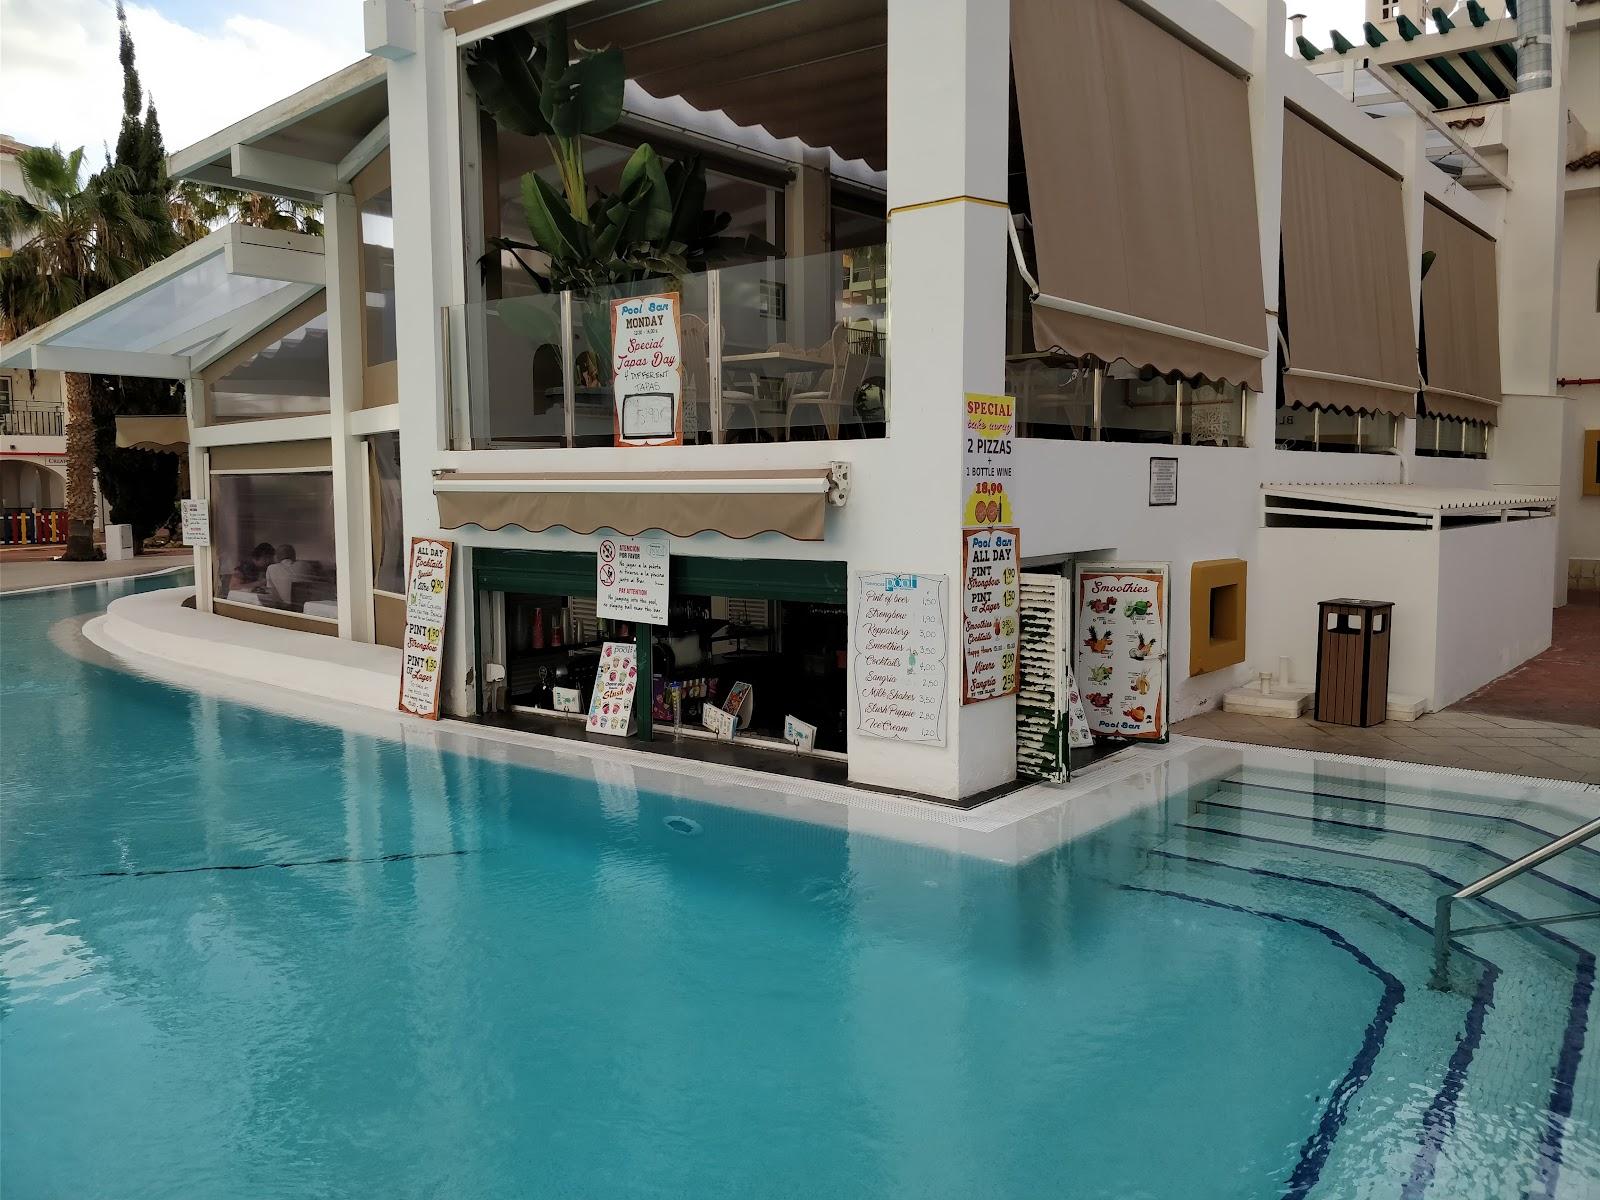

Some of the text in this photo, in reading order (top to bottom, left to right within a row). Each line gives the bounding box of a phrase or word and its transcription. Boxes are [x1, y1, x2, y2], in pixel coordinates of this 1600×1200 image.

[621, 302, 669, 316] Pool Bar
[626, 315, 664, 329] MONDAY
[627, 336, 665, 354] Special
[617, 351, 676, 370] Tapas Day
[630, 370, 669, 380] DIFFERENT
[634, 381, 661, 392] TAPAS
[967, 400, 1013, 417] SPECIAL
[967, 419, 1013, 436] take away
[967, 438, 1012, 455] 2 PIZZAS
[966, 467, 1012, 477] 1 BOTTLE WINE
[975, 482, 1003, 496] 18,90
[972, 536, 1012, 548] Pool Bar
[417, 546, 444, 558] ALL DAY
[972, 549, 1012, 563] ALL DAY
[415, 556, 444, 570] Cocktails
[417, 569, 433, 580] Special
[971, 566, 992, 577] PINT
[885, 574, 918, 592] pool
[967, 576, 1001, 591] Strongbow
[1091, 580, 1150, 594] Smoothies
[865, 590, 884, 602] Pint
[884, 593, 893, 606] of
[893, 593, 909, 604] beer
[971, 592, 992, 603] PINT
[979, 600, 1001, 613] Lager
[865, 607, 907, 623] Strongbow
[409, 623, 427, 637] PINT
[862, 622, 910, 641] Kopparberg
[965, 619, 993, 633] Smoothies
[407, 637, 438, 652] Strongbow
[968, 631, 992, 645] Cocktails
[865, 639, 904, 652] Smoothies
[407, 654, 425, 668] PINT
[864, 654, 901, 668] Cocktails
[406, 666, 433, 683] OF Lager
[865, 670, 897, 686] Sangria
[602, 687, 625, 700] Slush
[861, 687, 887, 698] Milk
[887, 688, 916, 701] Shakes
[864, 702, 888, 714] Slush
[888, 703, 915, 719] Puppie
[865, 717, 882, 729] Ice
[881, 719, 909, 733] Cream
[1098, 719, 1141, 730] Pool Bar
